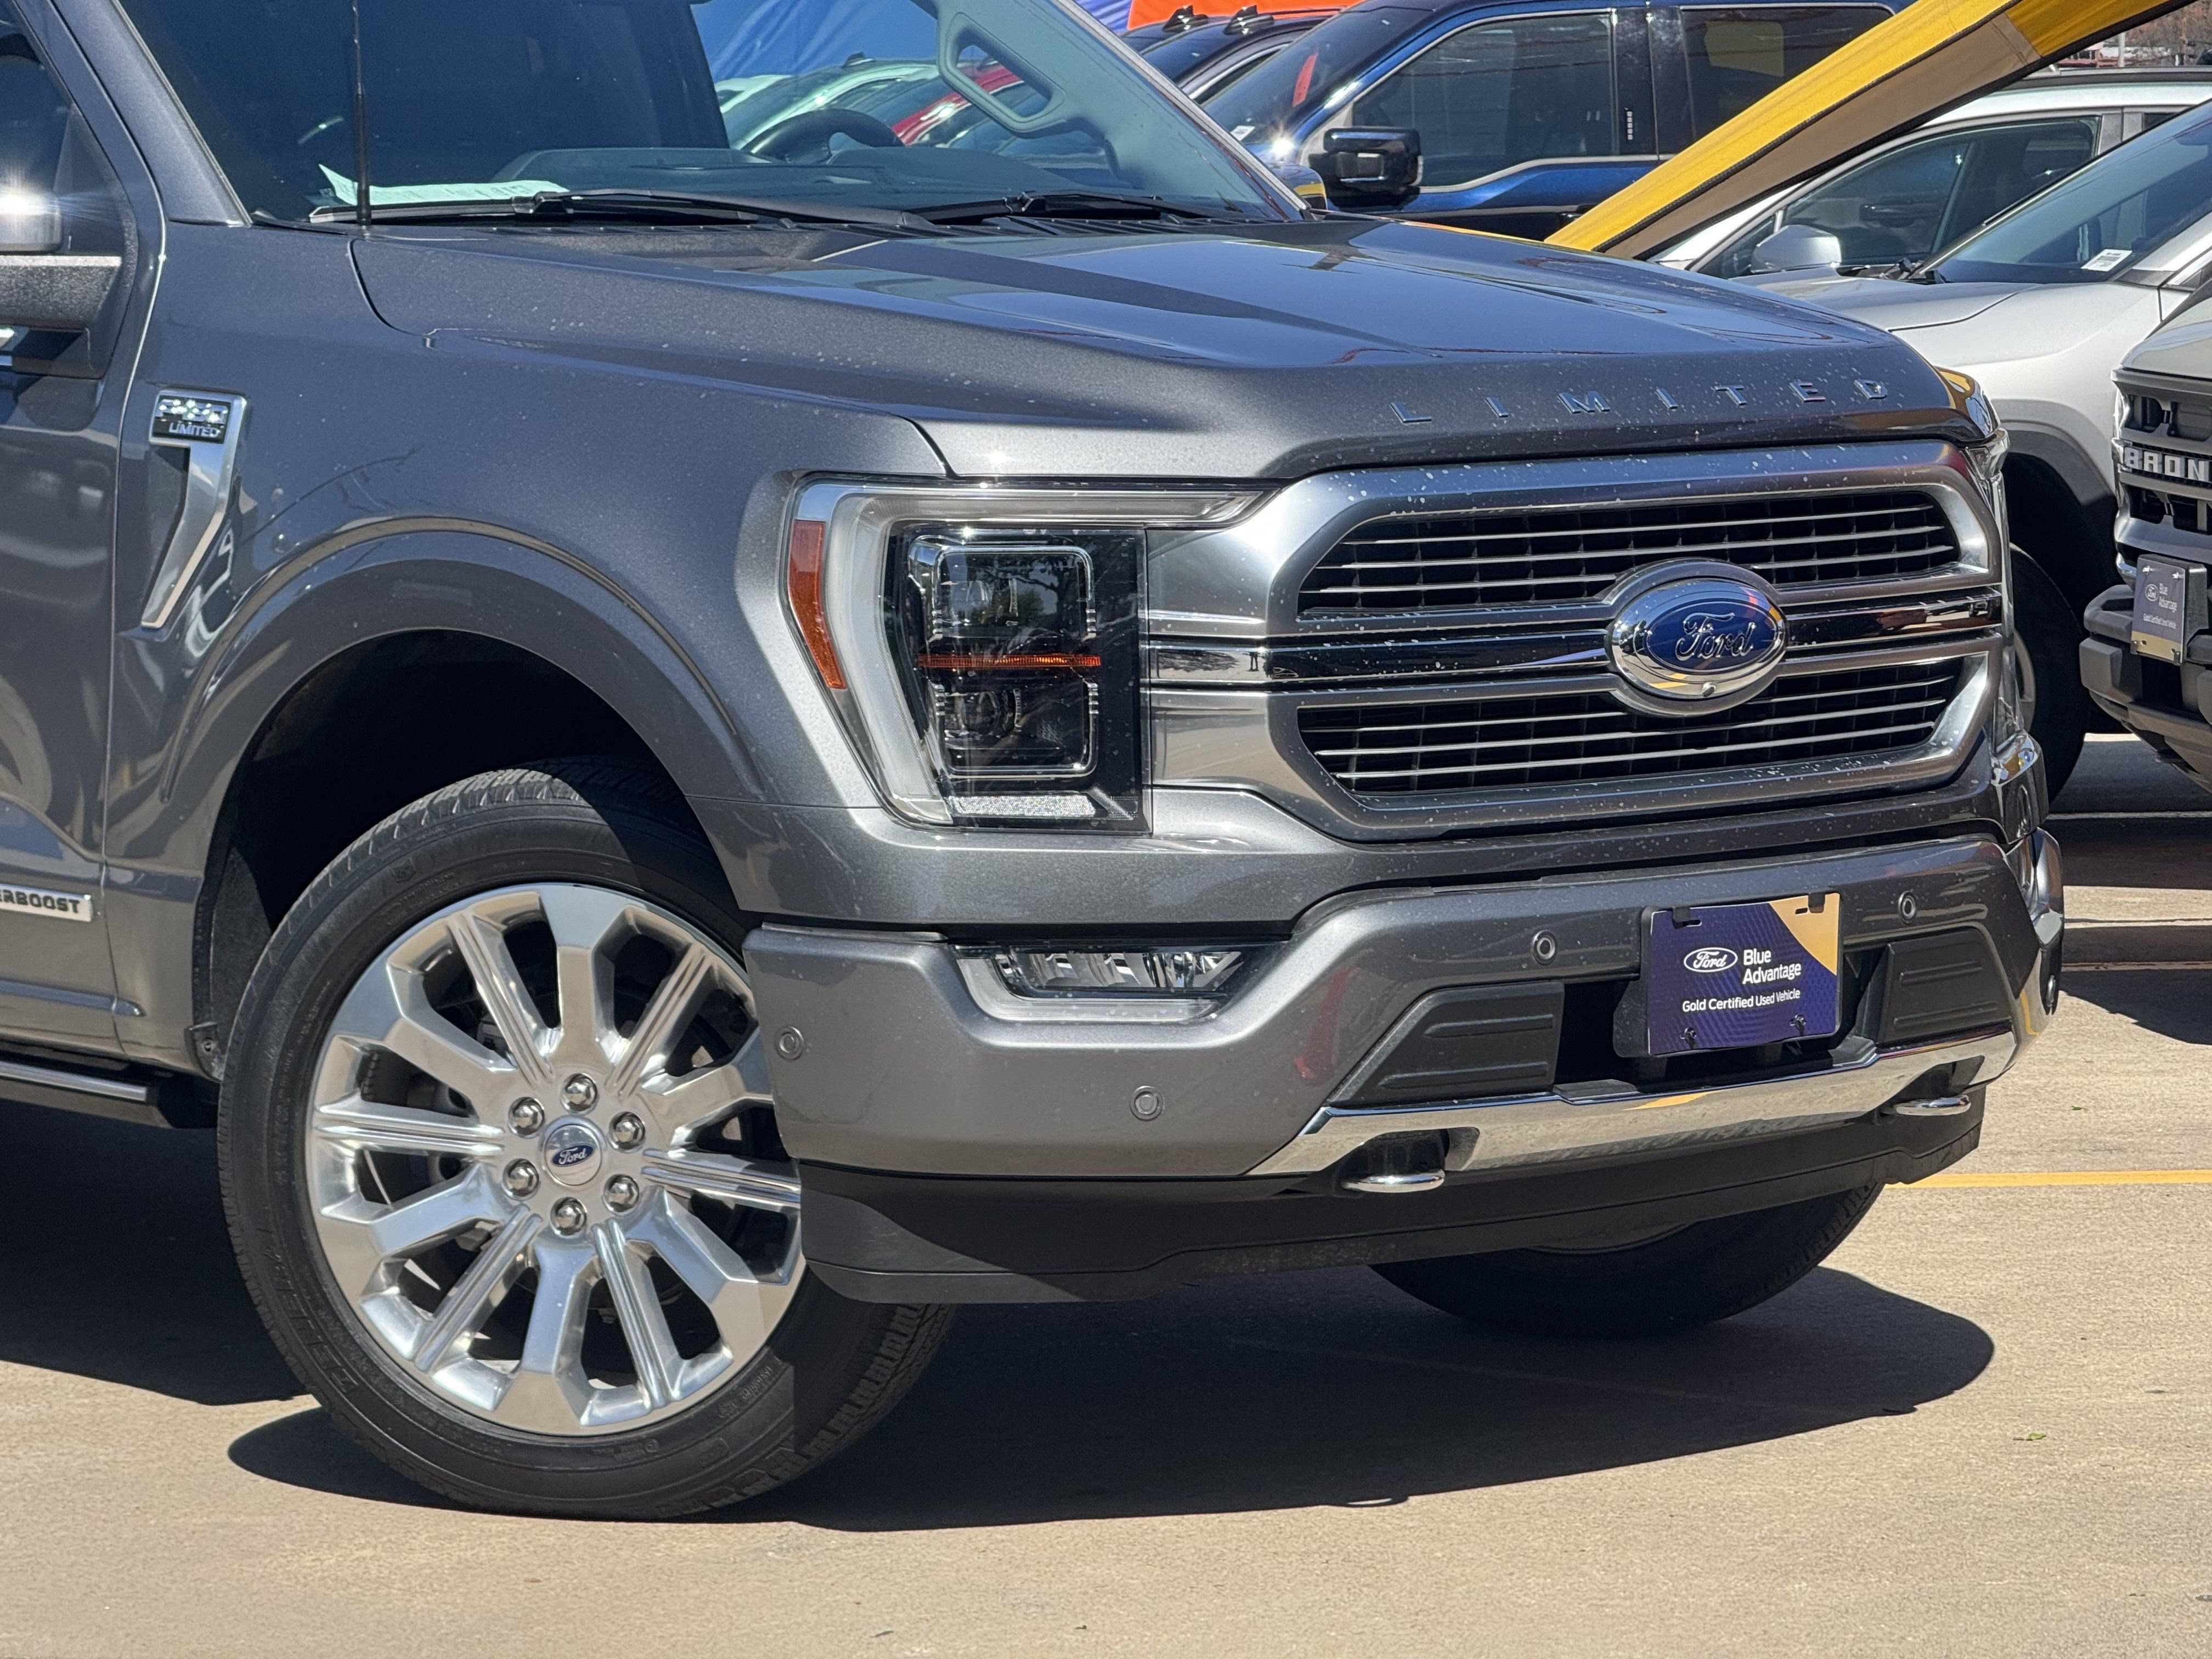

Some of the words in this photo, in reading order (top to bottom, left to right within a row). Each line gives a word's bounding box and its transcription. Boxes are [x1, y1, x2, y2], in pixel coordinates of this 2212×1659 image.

[1390, 379, 1888, 425] LIMITED
[169, 421, 221, 438] LIMITED
[1675, 612, 1756, 661] Ford
[0, 889, 79, 913] RBOOST
[1693, 951, 1728, 968] Ford
[1743, 949, 1771, 966] Blue
[1742, 963, 1802, 985] Advantage
[1682, 999, 1706, 1012] Gold
[1708, 995, 1754, 1010] Certified
[1755, 992, 1775, 1006] Used
[1775, 988, 1801, 1002] Vehicle
[558, 1147, 588, 1165] Ford
